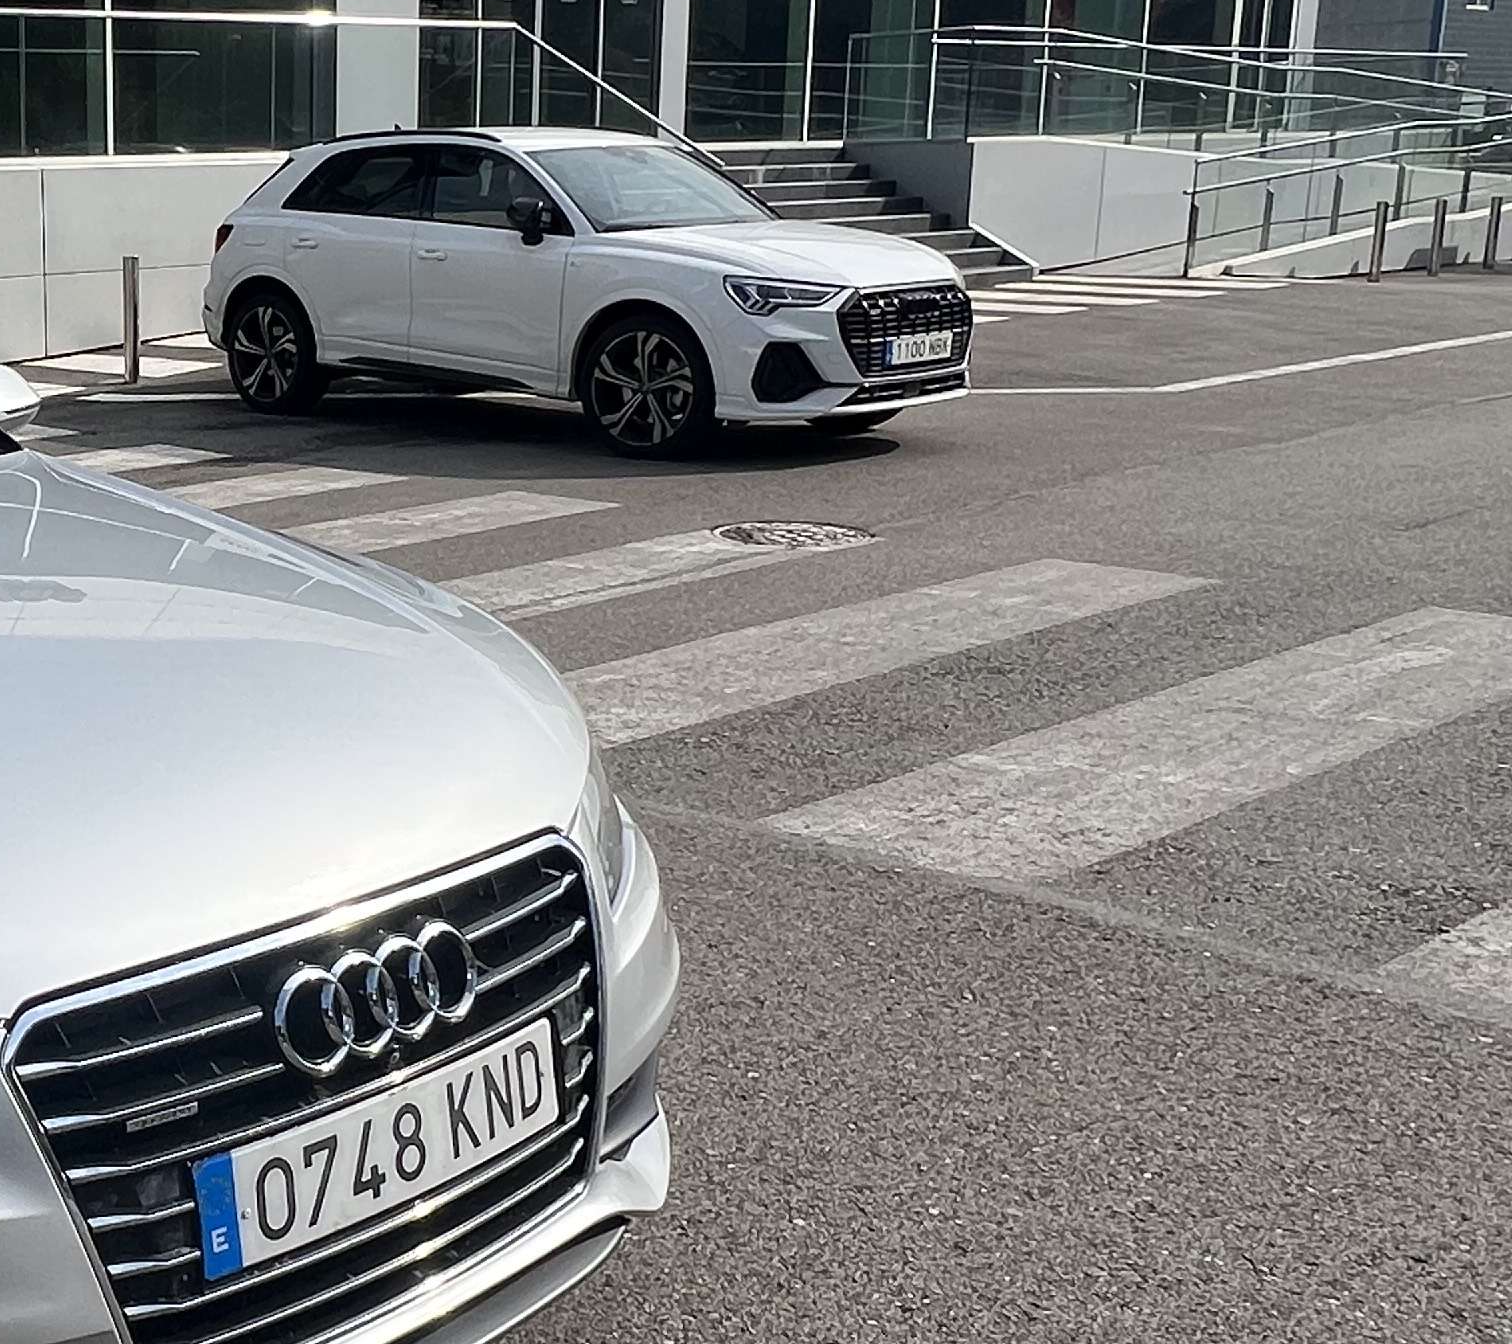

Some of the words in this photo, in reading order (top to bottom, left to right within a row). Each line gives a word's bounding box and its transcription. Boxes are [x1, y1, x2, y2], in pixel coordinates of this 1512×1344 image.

[897, 340, 925, 359] 1100
[255, 1102, 426, 1241] 0748
[445, 1039, 544, 1159] KND
[211, 1226, 229, 1252] E
